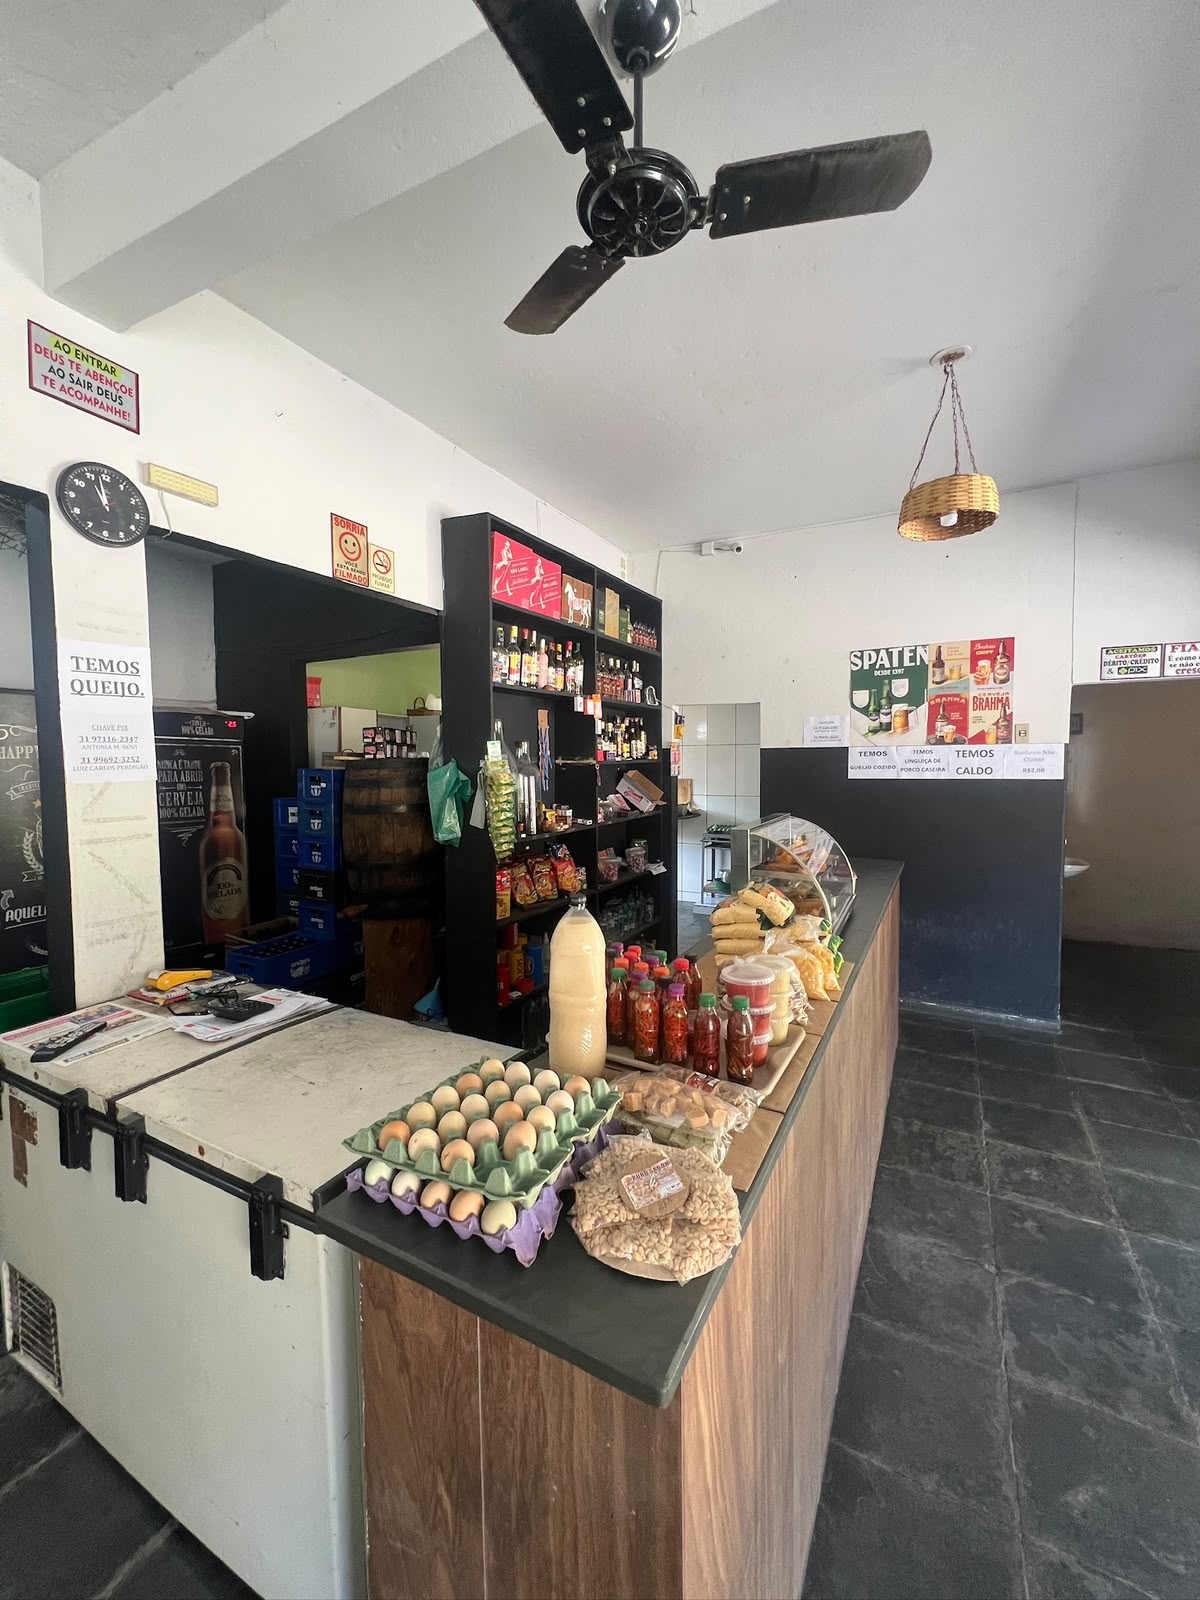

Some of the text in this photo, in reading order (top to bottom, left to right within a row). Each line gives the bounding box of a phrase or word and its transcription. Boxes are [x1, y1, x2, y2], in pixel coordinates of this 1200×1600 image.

[54, 340, 117, 377] AO ENTRAR
[34, 343, 133, 397] DEUS TE ABENÇOE
[48, 365, 124, 406] AO SAIR DEUS
[41, 374, 130, 422] TE ACOMPANHE!
[73, 479, 86, 488] 10
[85, 472, 95, 481] 11
[101, 473, 111, 482] 12
[68, 491, 76, 499] 9
[86, 521, 93, 529] 7
[334, 517, 365, 537] SORRIA
[335, 568, 368, 585] FILMADO
[70, 656, 140, 675] TEMOS
[850, 645, 929, 671] SPATEN
[70, 679, 144, 697] QUEIJO.
[930, 697, 966, 706] BRAHMA
[973, 696, 1010, 711] BRAHMA
[955, 750, 995, 758] TEMOS
[956, 767, 993, 775] CALDO
[159, 791, 204, 806] CERVEJA
[180, 806, 205, 817] GELADA
